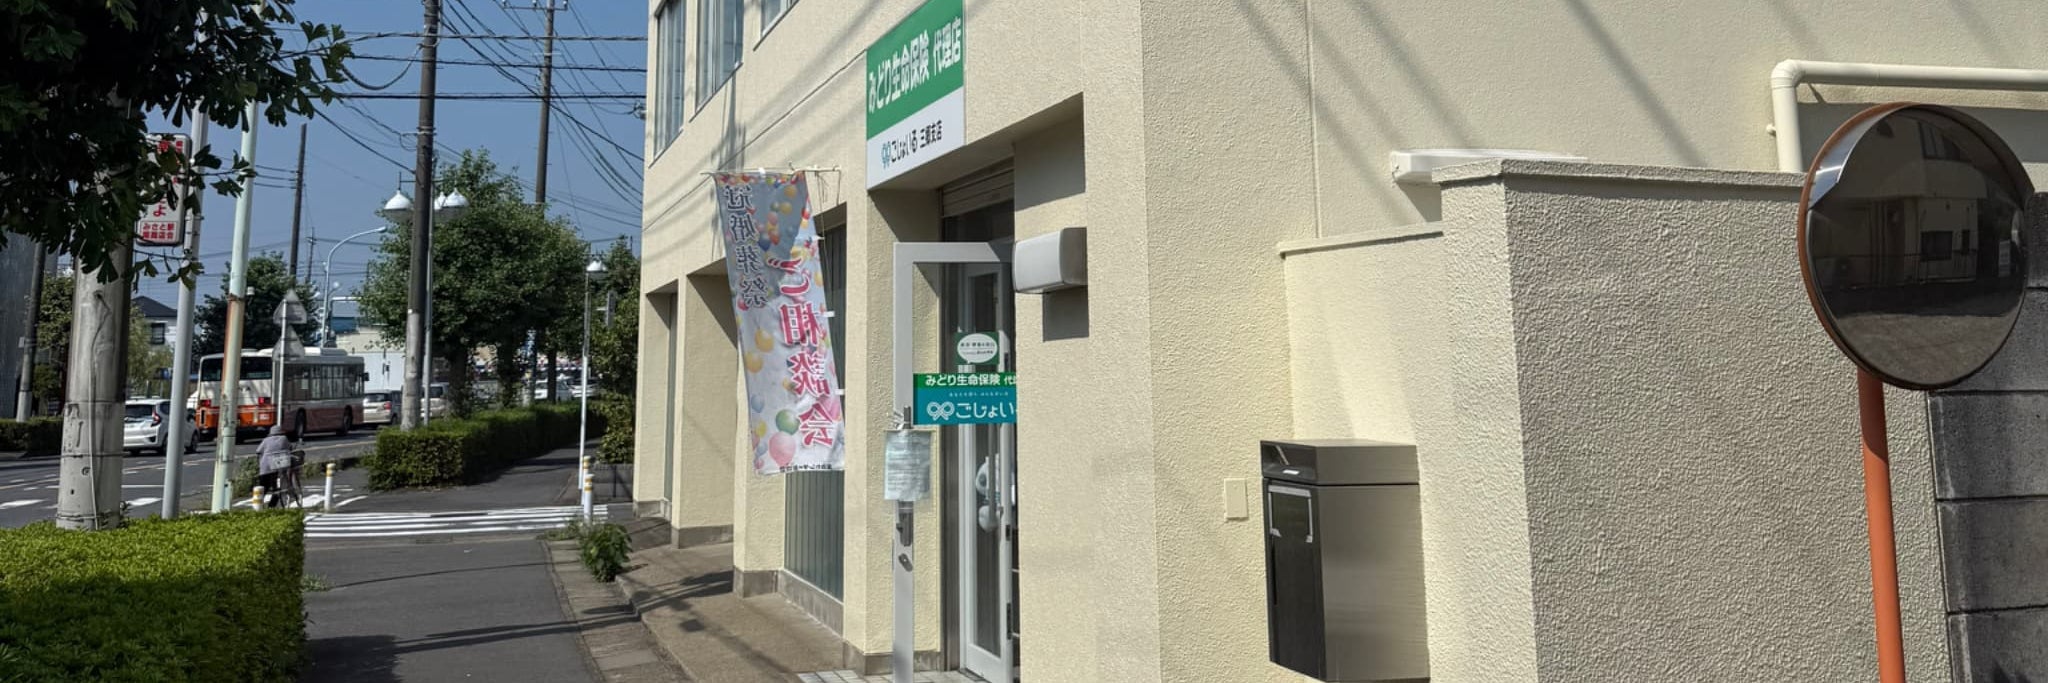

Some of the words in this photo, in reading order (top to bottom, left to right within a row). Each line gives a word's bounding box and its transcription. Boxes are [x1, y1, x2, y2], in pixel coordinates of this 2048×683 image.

[868, 30, 930, 113] みどり生命保険
[933, 16, 962, 76] 代理店
[891, 129, 918, 163] ごじょいる
[925, 373, 1001, 386] みどり生命保険
[956, 402, 1017, 419] ごじょい
